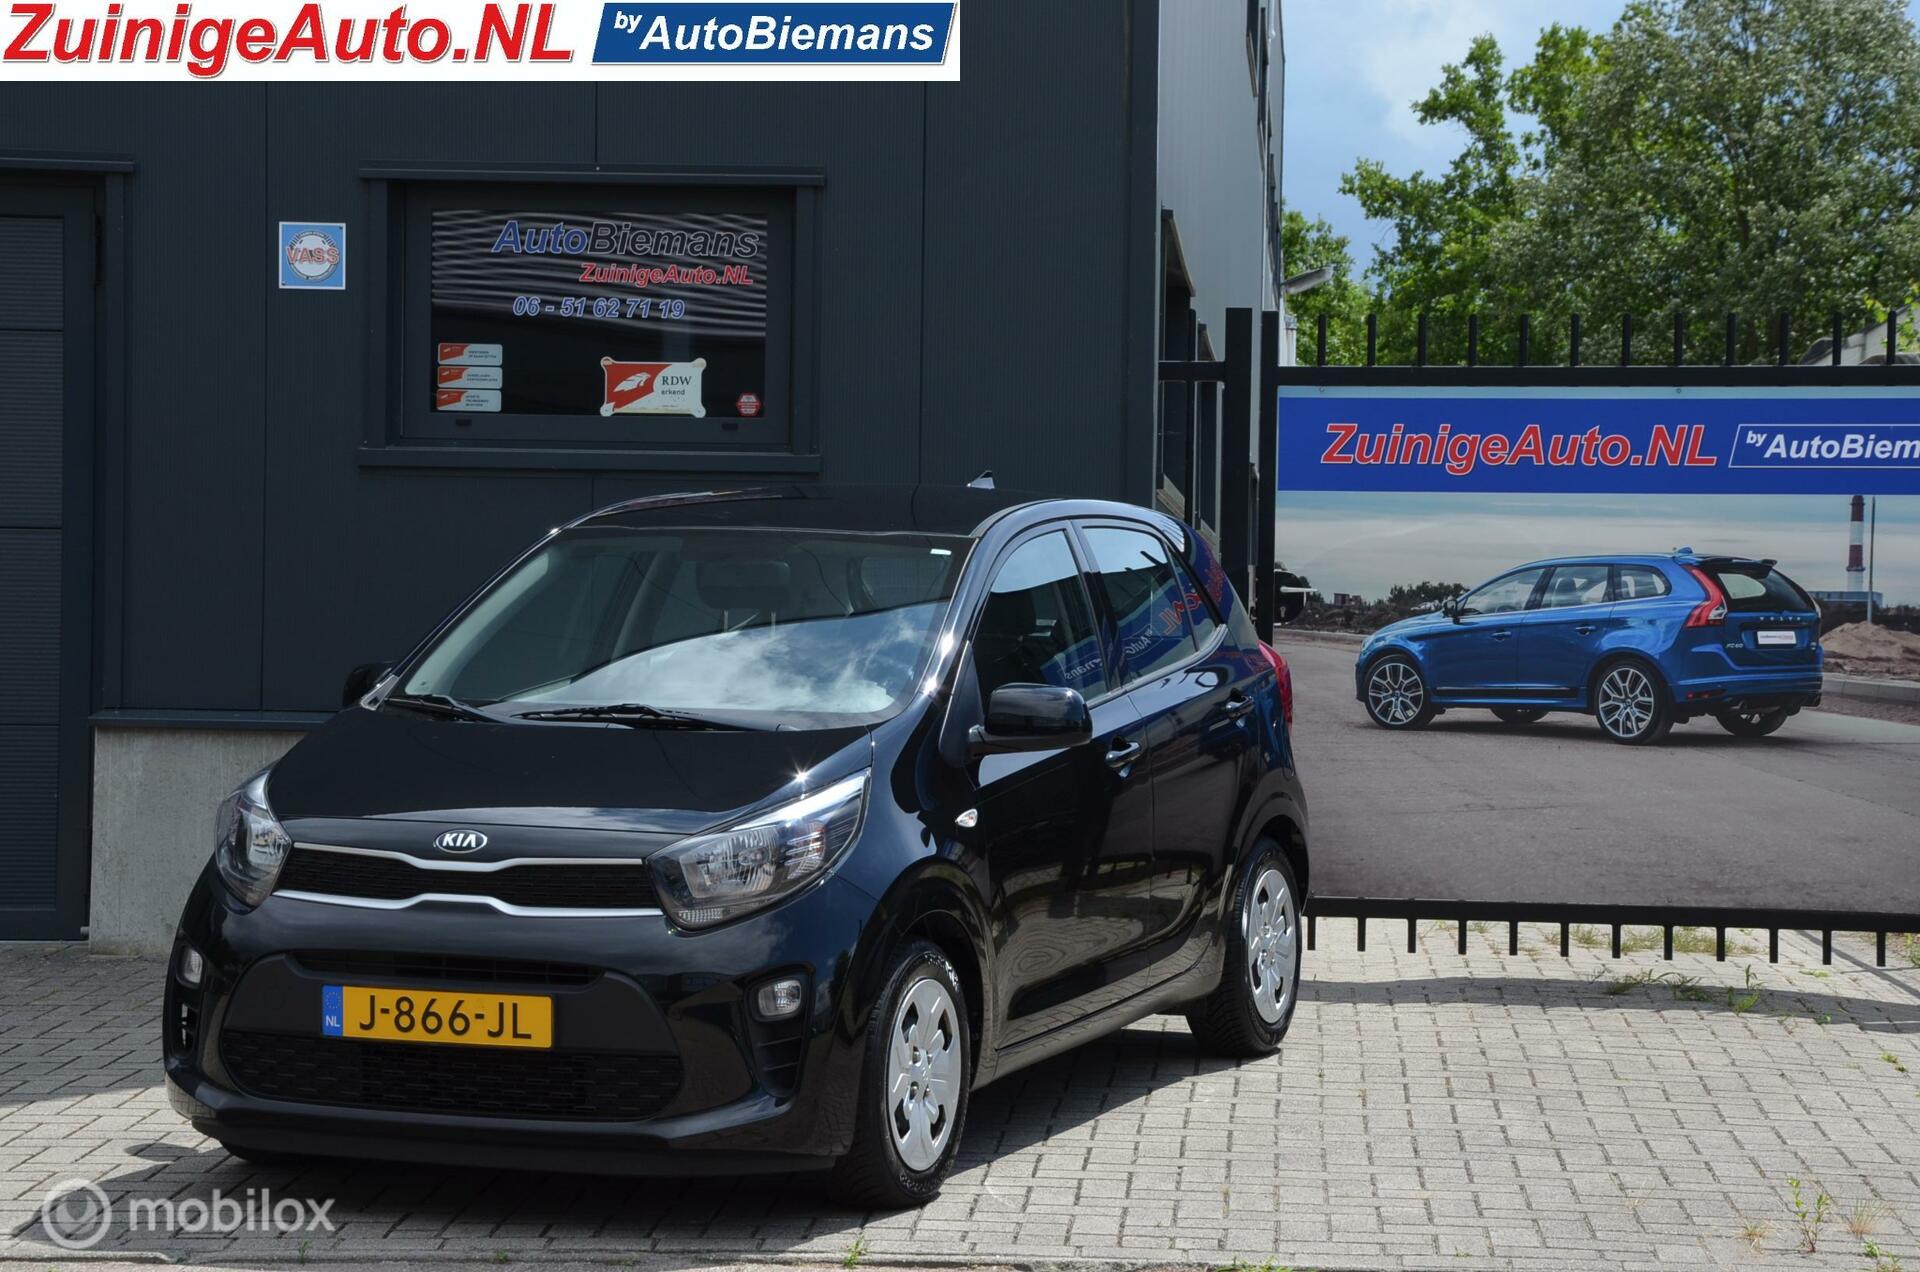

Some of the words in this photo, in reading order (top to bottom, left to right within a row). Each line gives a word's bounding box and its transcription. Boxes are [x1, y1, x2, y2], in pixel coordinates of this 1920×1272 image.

[491, 219, 760, 258] AutoBiemans
[286, 247, 340, 266] VASS
[577, 261, 754, 289] ZuinigeAuto.NL
[512, 295, 540, 316] 06
[560, 296, 586, 318] 51
[592, 297, 619, 319] 62
[626, 297, 651, 319] 71
[659, 299, 686, 320] 19
[661, 375, 692, 386] RDW
[661, 388, 685, 396] erkend
[1320, 422, 1719, 477] ZuinigeAuto.NL
[1745, 431, 1767, 447] by
[442, 832, 477, 849] KIA
[325, 1015, 341, 1028] NL
[359, 994, 532, 1041] J-866-JL
